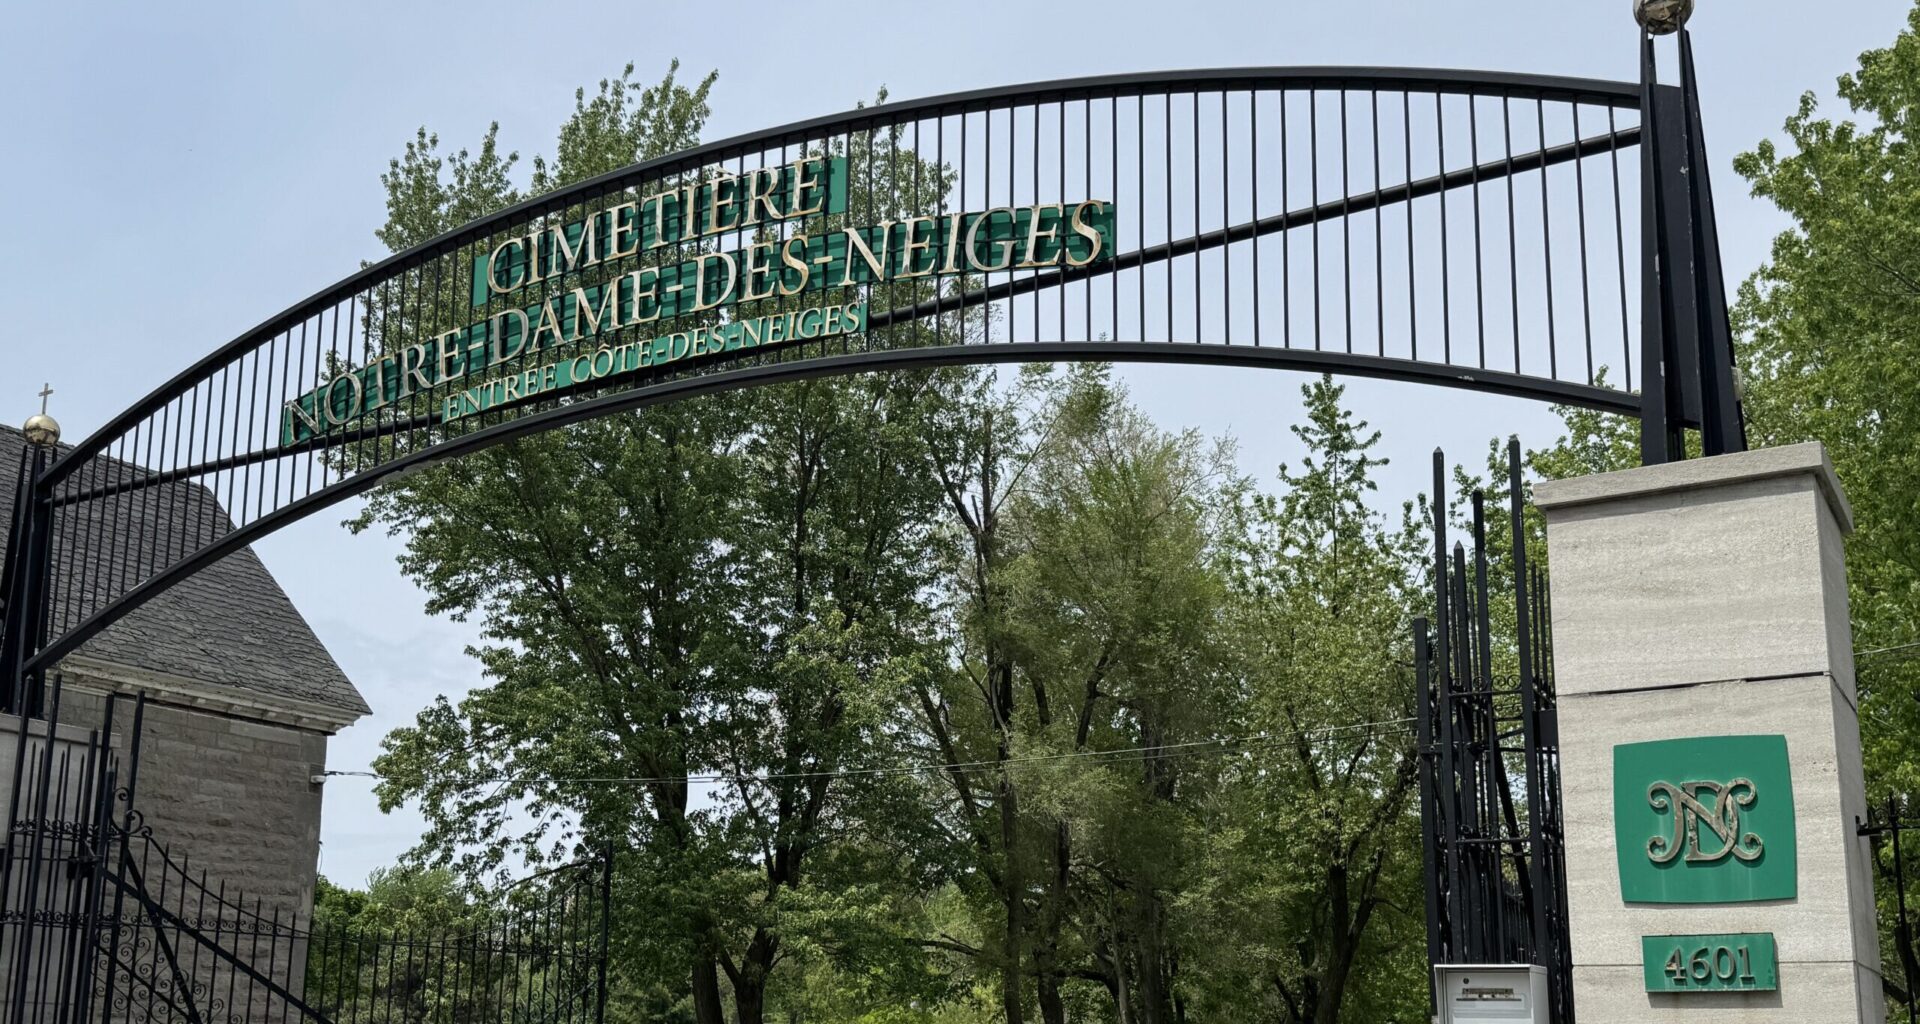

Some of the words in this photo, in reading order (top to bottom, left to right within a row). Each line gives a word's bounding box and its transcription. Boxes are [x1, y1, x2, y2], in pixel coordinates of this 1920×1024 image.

[487, 156, 825, 294] CIMETIÈRE
[284, 200, 1105, 443] NOTRE-DAME-DES-NEIGES
[445, 362, 557, 422] ENTRÉE
[570, 301, 861, 383] CÔTE-DES-NEIGES
[1664, 946, 1755, 984] 4601
